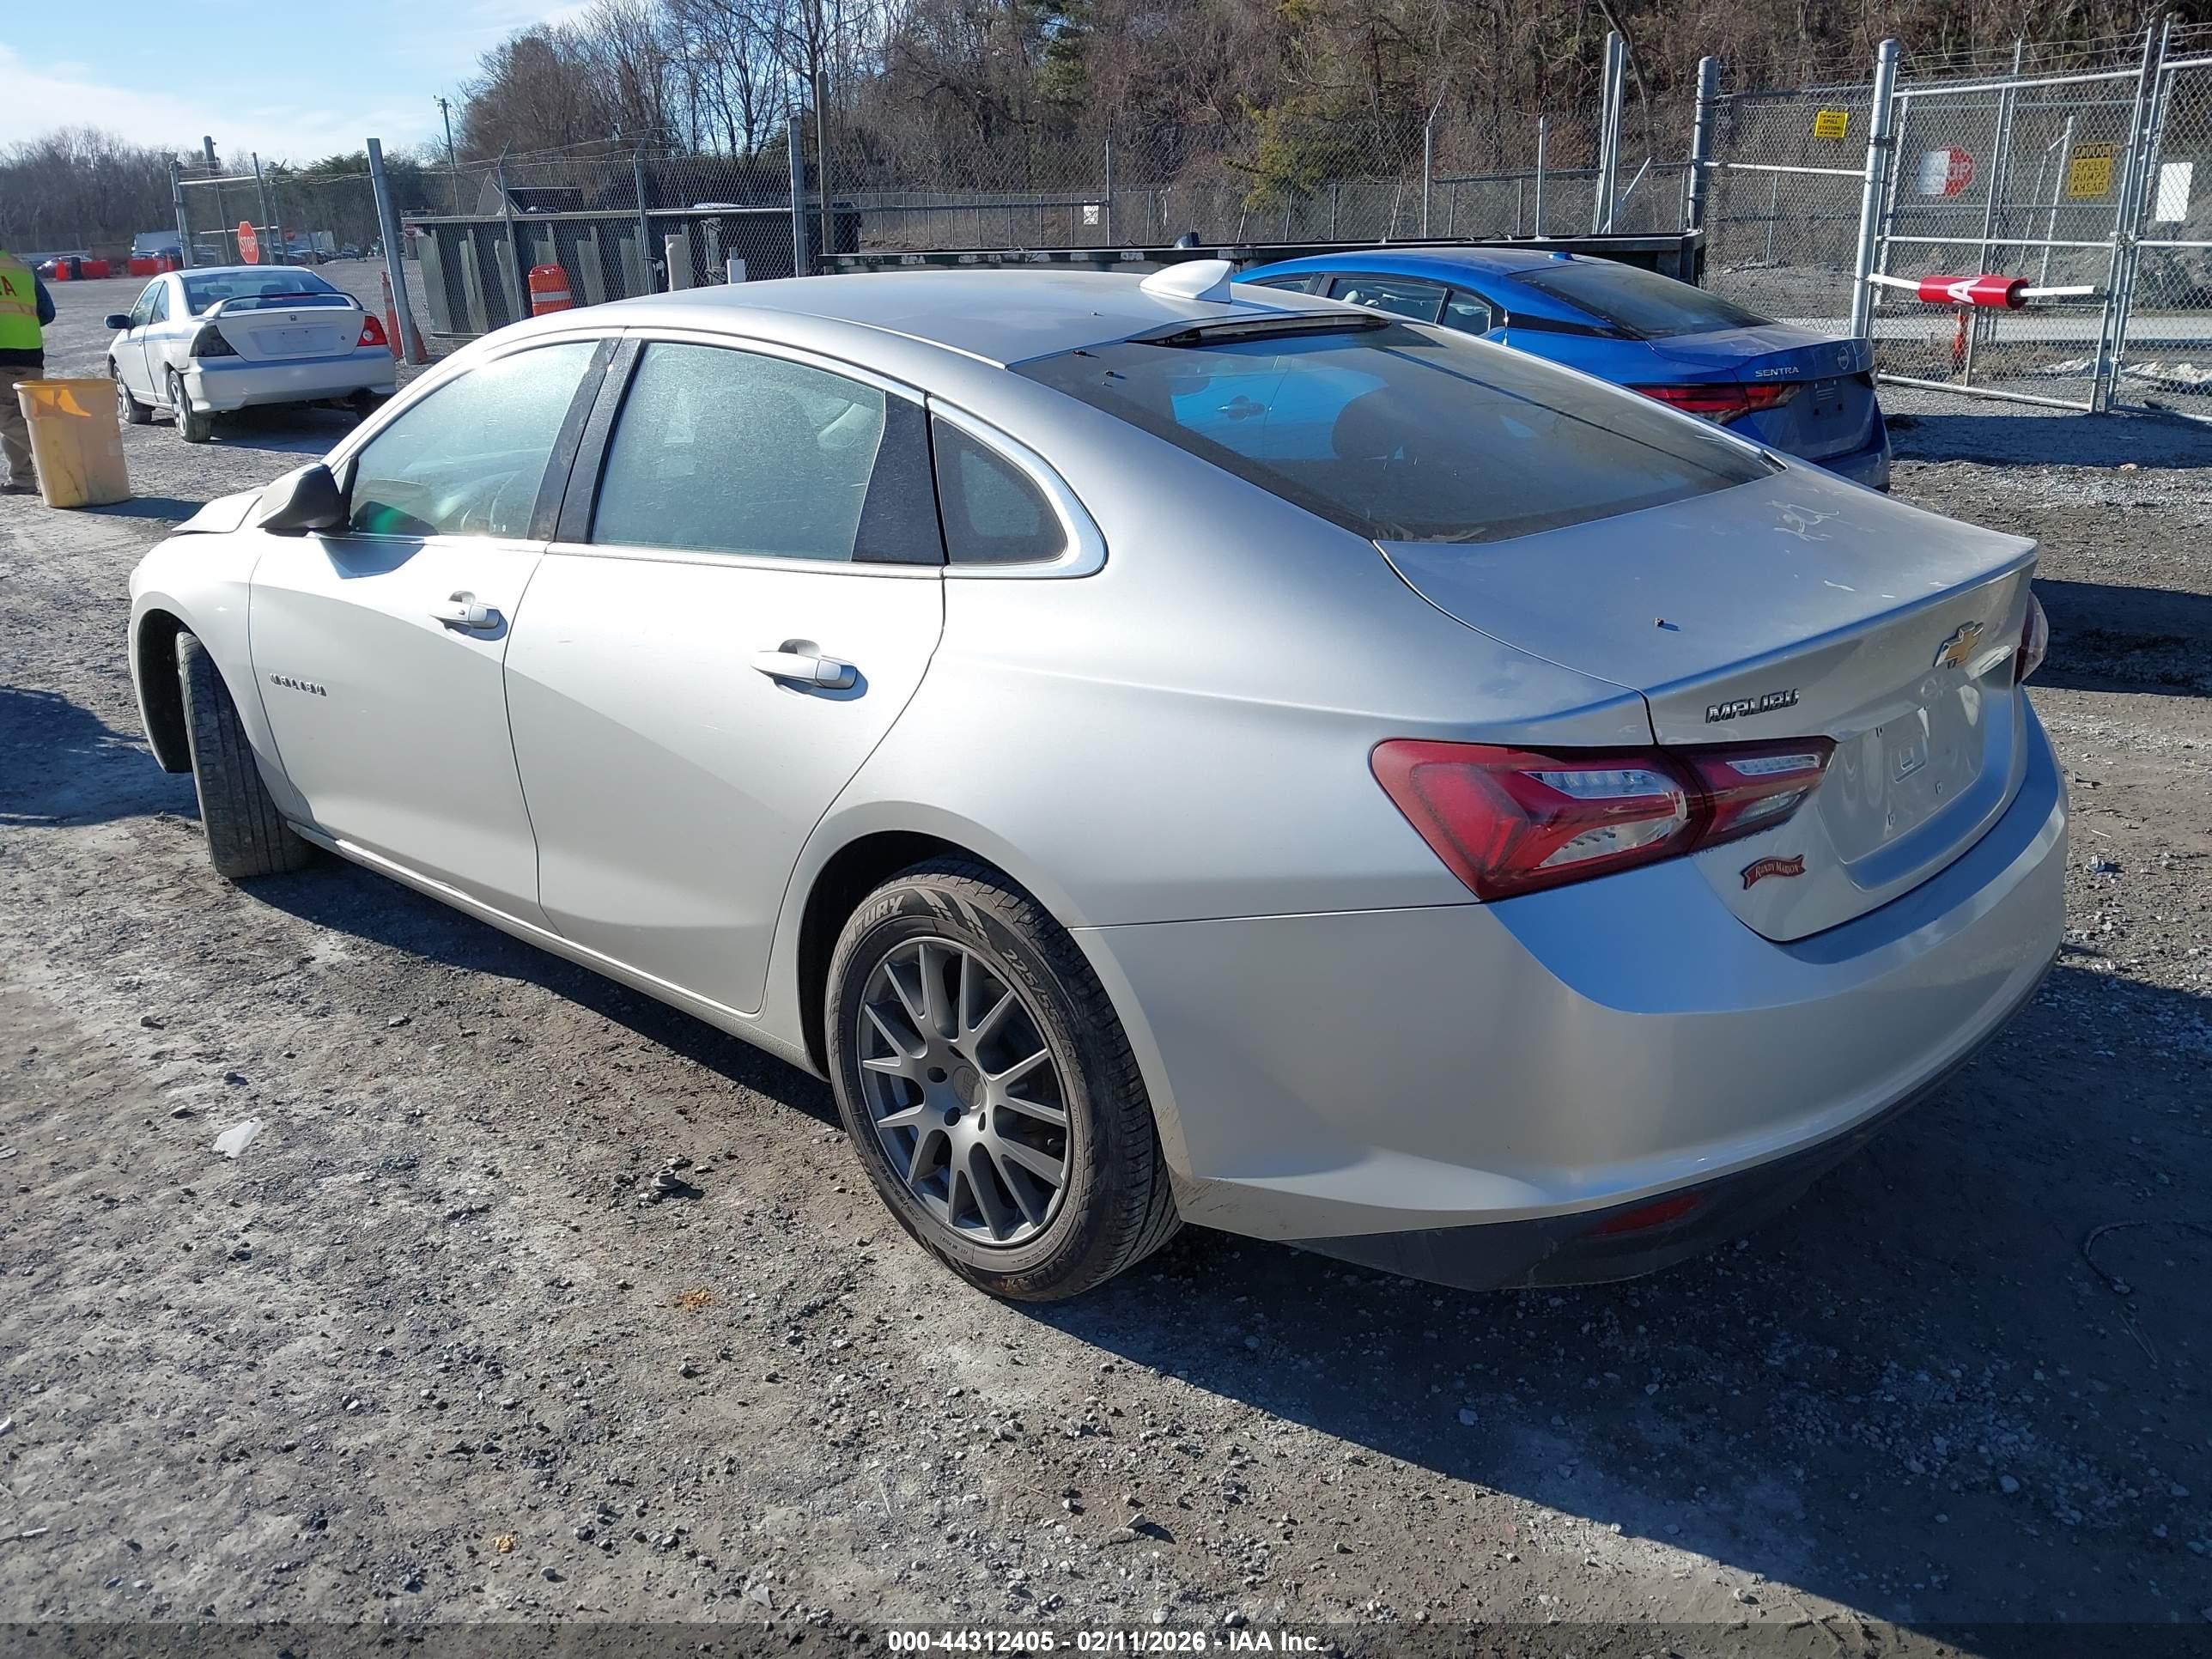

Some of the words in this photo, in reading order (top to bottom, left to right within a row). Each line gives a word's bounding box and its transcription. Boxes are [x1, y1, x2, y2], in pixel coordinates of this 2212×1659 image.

[240, 235, 256, 252] STOP
[1754, 366, 1800, 378] SENTRA
[1705, 688, 1800, 724] MALIBU
[1755, 863, 1776, 878] RANDY
